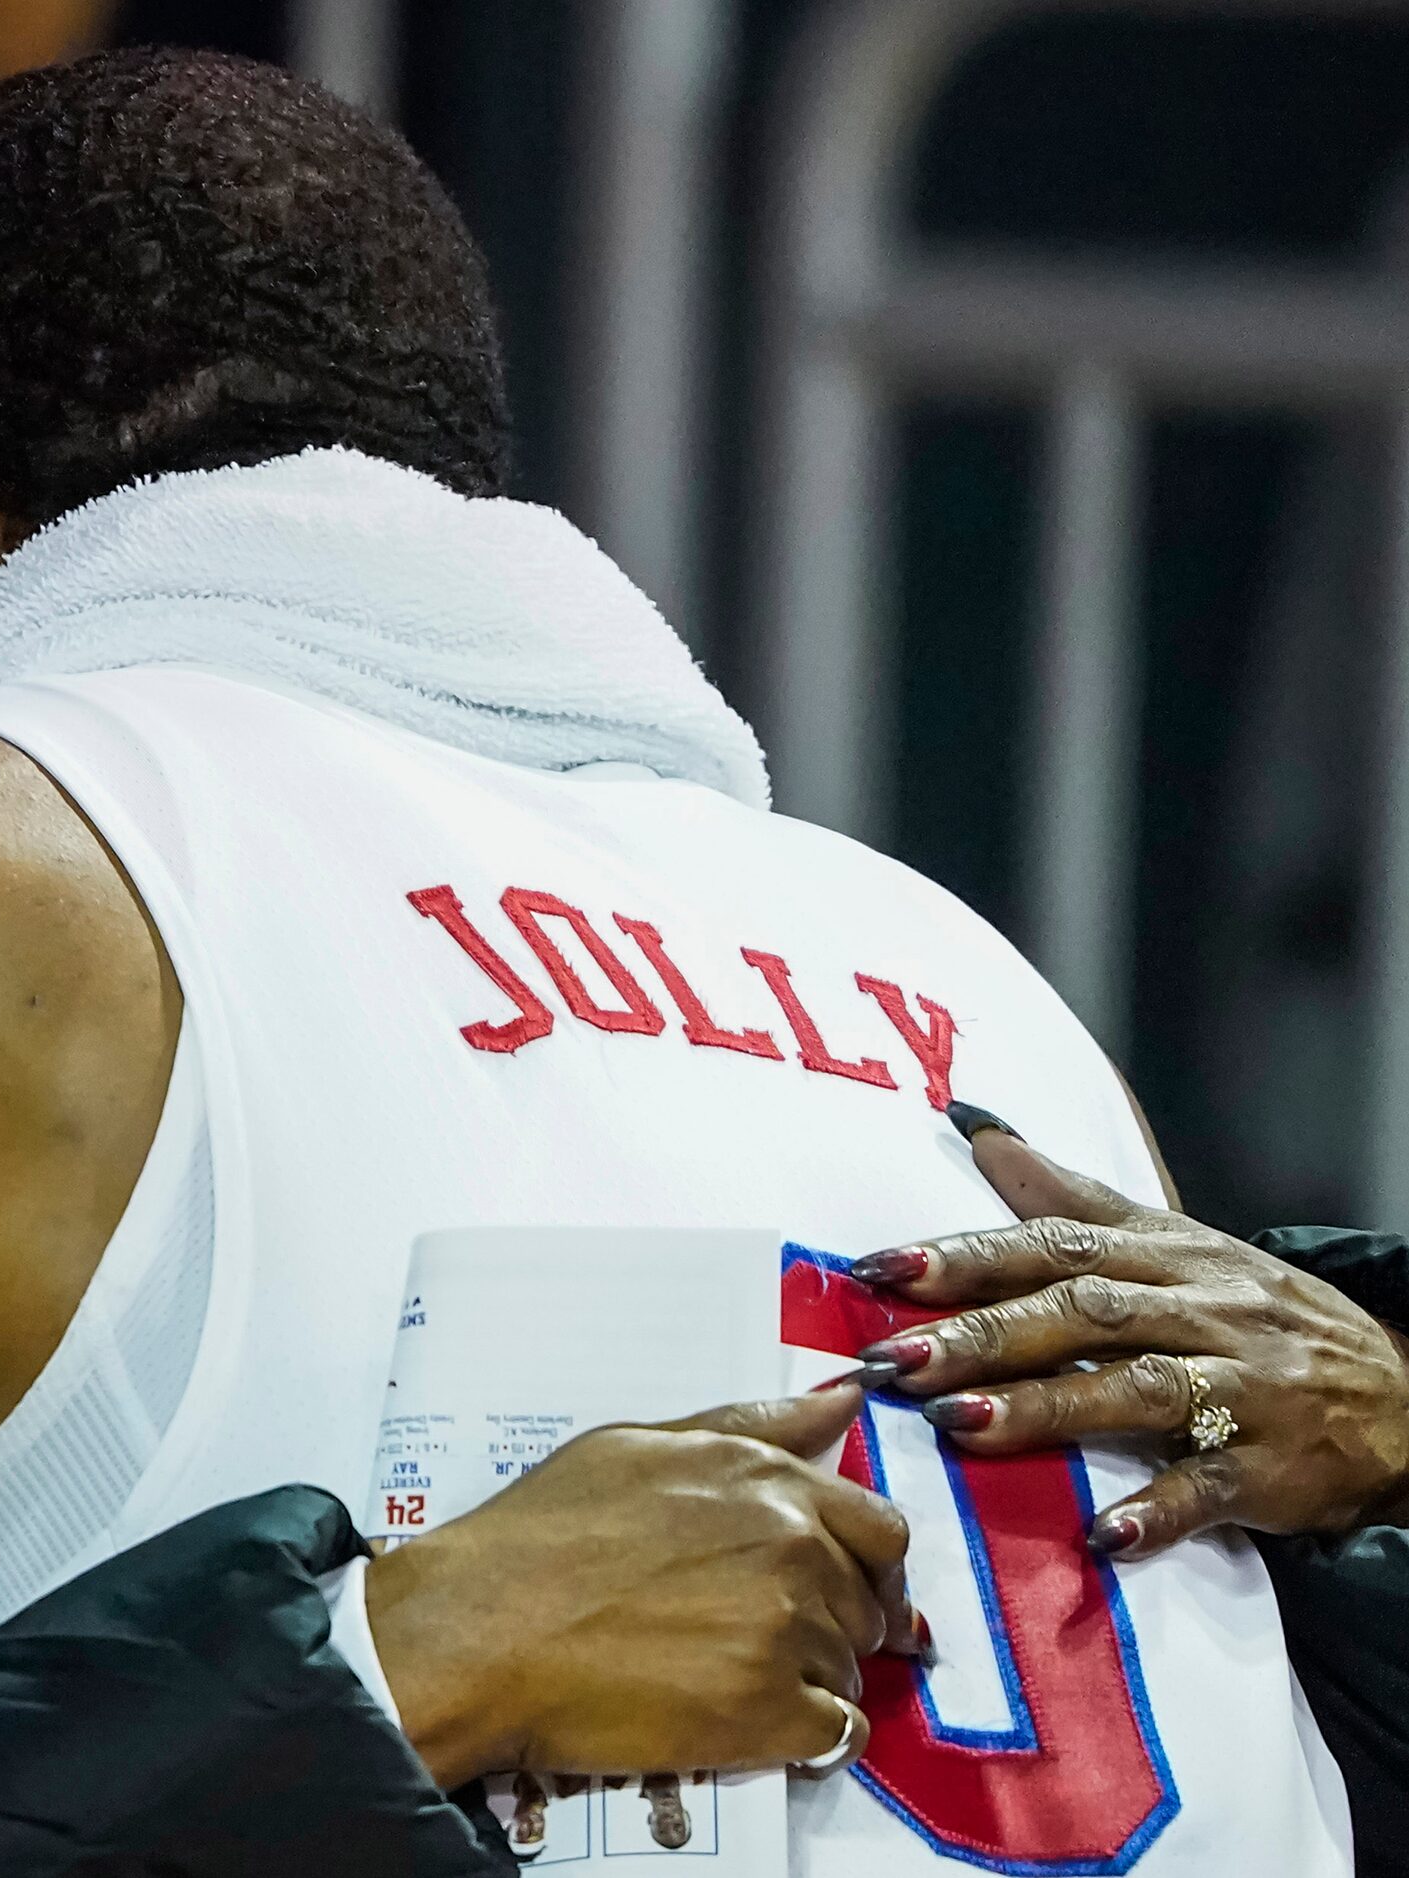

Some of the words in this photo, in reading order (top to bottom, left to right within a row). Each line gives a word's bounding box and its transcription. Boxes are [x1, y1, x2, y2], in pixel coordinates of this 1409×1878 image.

[405, 884, 958, 1112] JOLLY
[393, 1461, 418, 1474] RAY
[492, 1461, 514, 1475] JR.
[380, 1476, 431, 1490] EVERETT
[386, 1495, 425, 1525] 24
